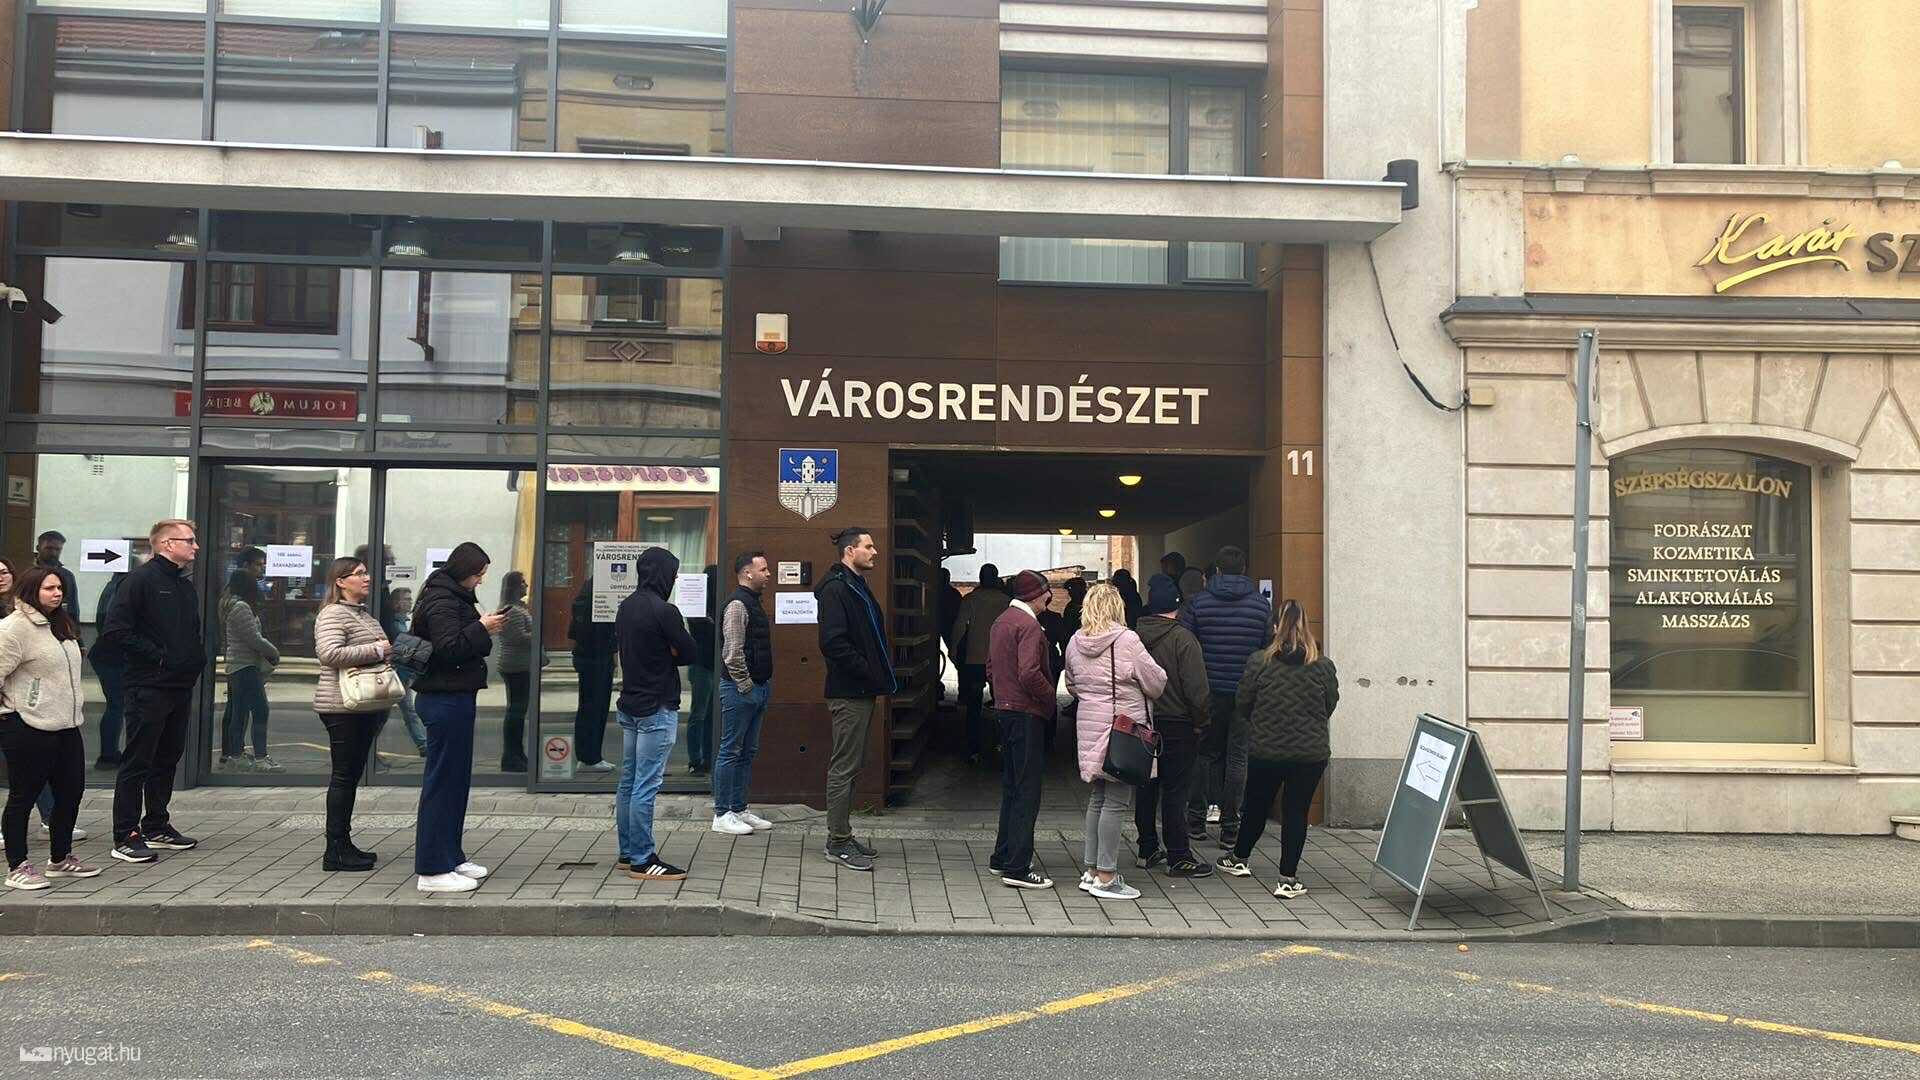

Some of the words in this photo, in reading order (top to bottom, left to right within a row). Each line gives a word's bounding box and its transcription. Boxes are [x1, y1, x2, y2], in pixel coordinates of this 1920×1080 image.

[780, 368, 1209, 425] VÁROSRENDÉSZET
[1287, 450, 1314, 476] 11
[1614, 466, 1792, 498] SZÉPSÉGSZALON
[1653, 521, 1753, 538] FODRÁSZAT
[1652, 547, 1755, 560] KOZMETIKA
[1627, 566, 1781, 583] SMINKTETOVÁLÁS
[1635, 588, 1774, 606] ALAKFORMÁLÁS
[1661, 611, 1750, 629] MASSZÁZS
